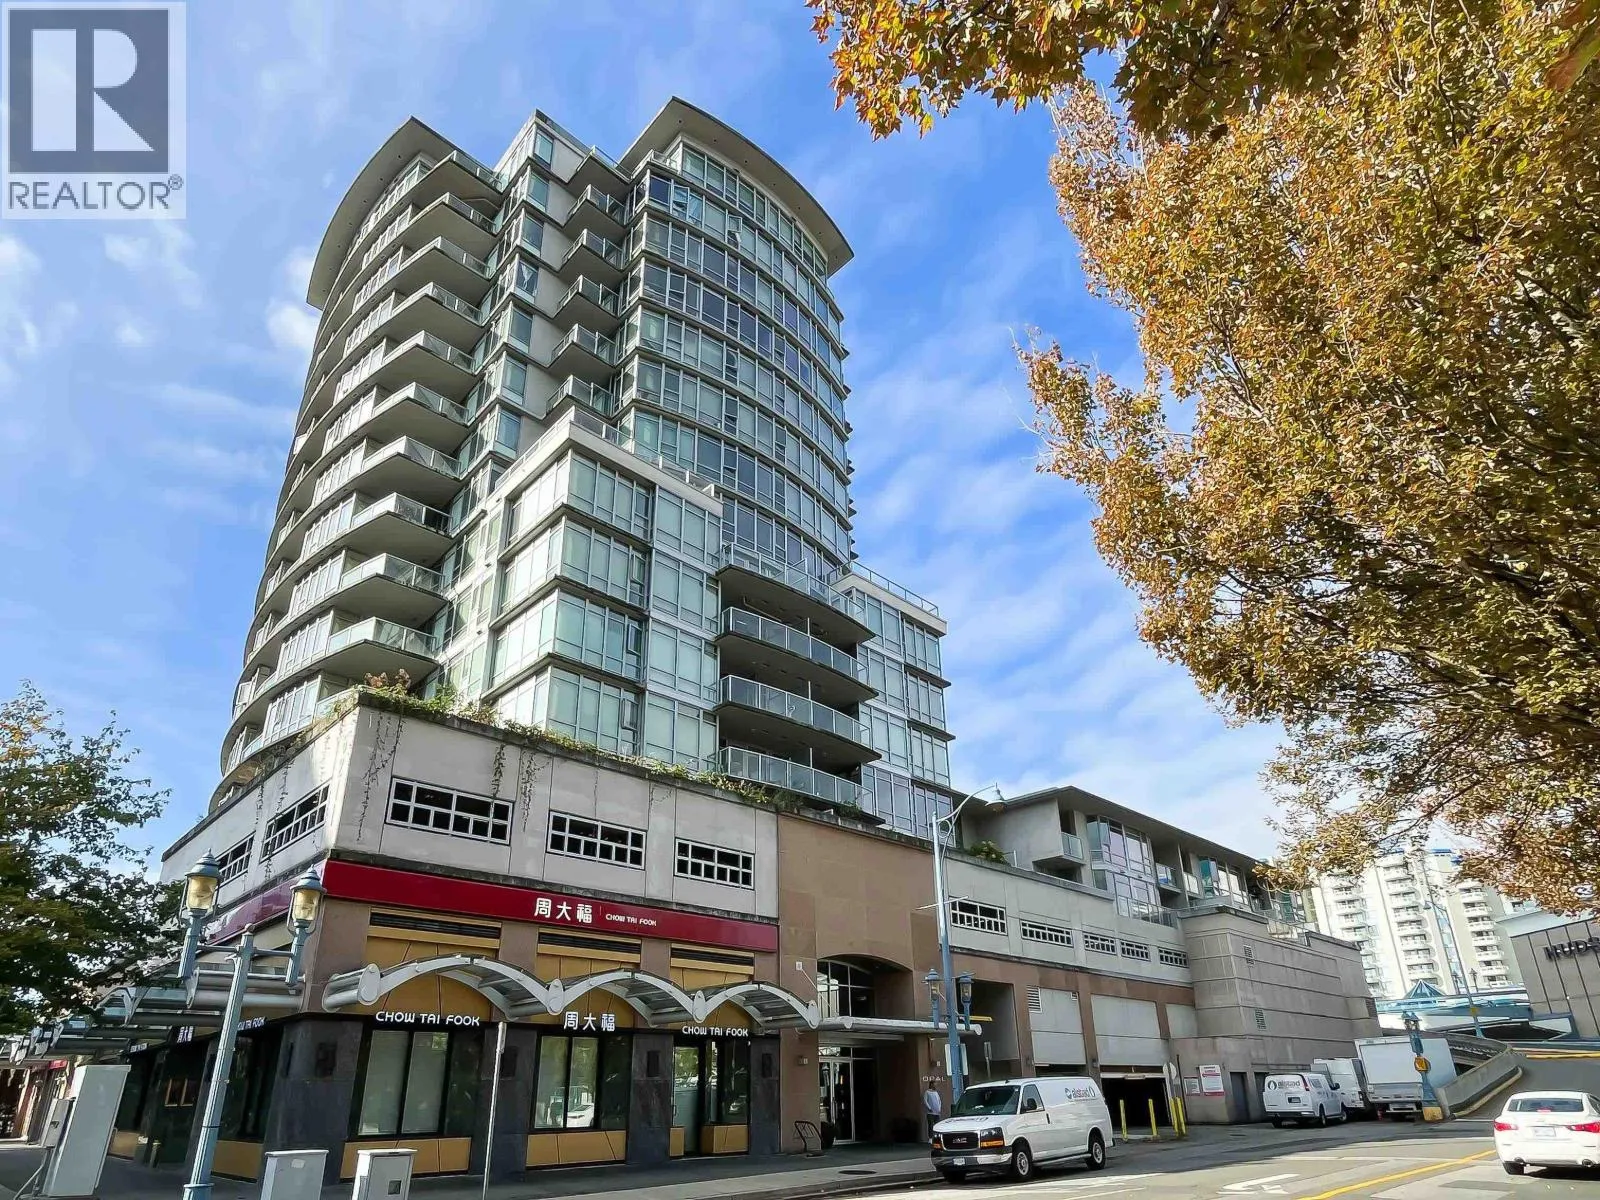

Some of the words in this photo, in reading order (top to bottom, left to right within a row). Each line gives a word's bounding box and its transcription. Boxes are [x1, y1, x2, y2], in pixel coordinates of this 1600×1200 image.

[534, 897, 592, 923] 周大福
[605, 913, 625, 923] CHOW
[626, 916, 638, 924] TAI
[639, 918, 657, 926] FOOK
[375, 1011, 415, 1023] CHOW
[419, 1013, 440, 1025] TAI
[445, 1014, 480, 1026] FOOK
[563, 1011, 616, 1032] 周大福
[682, 1025, 707, 1036] CHOW
[709, 1027, 723, 1036] TAI
[725, 1027, 749, 1037] FOOK
